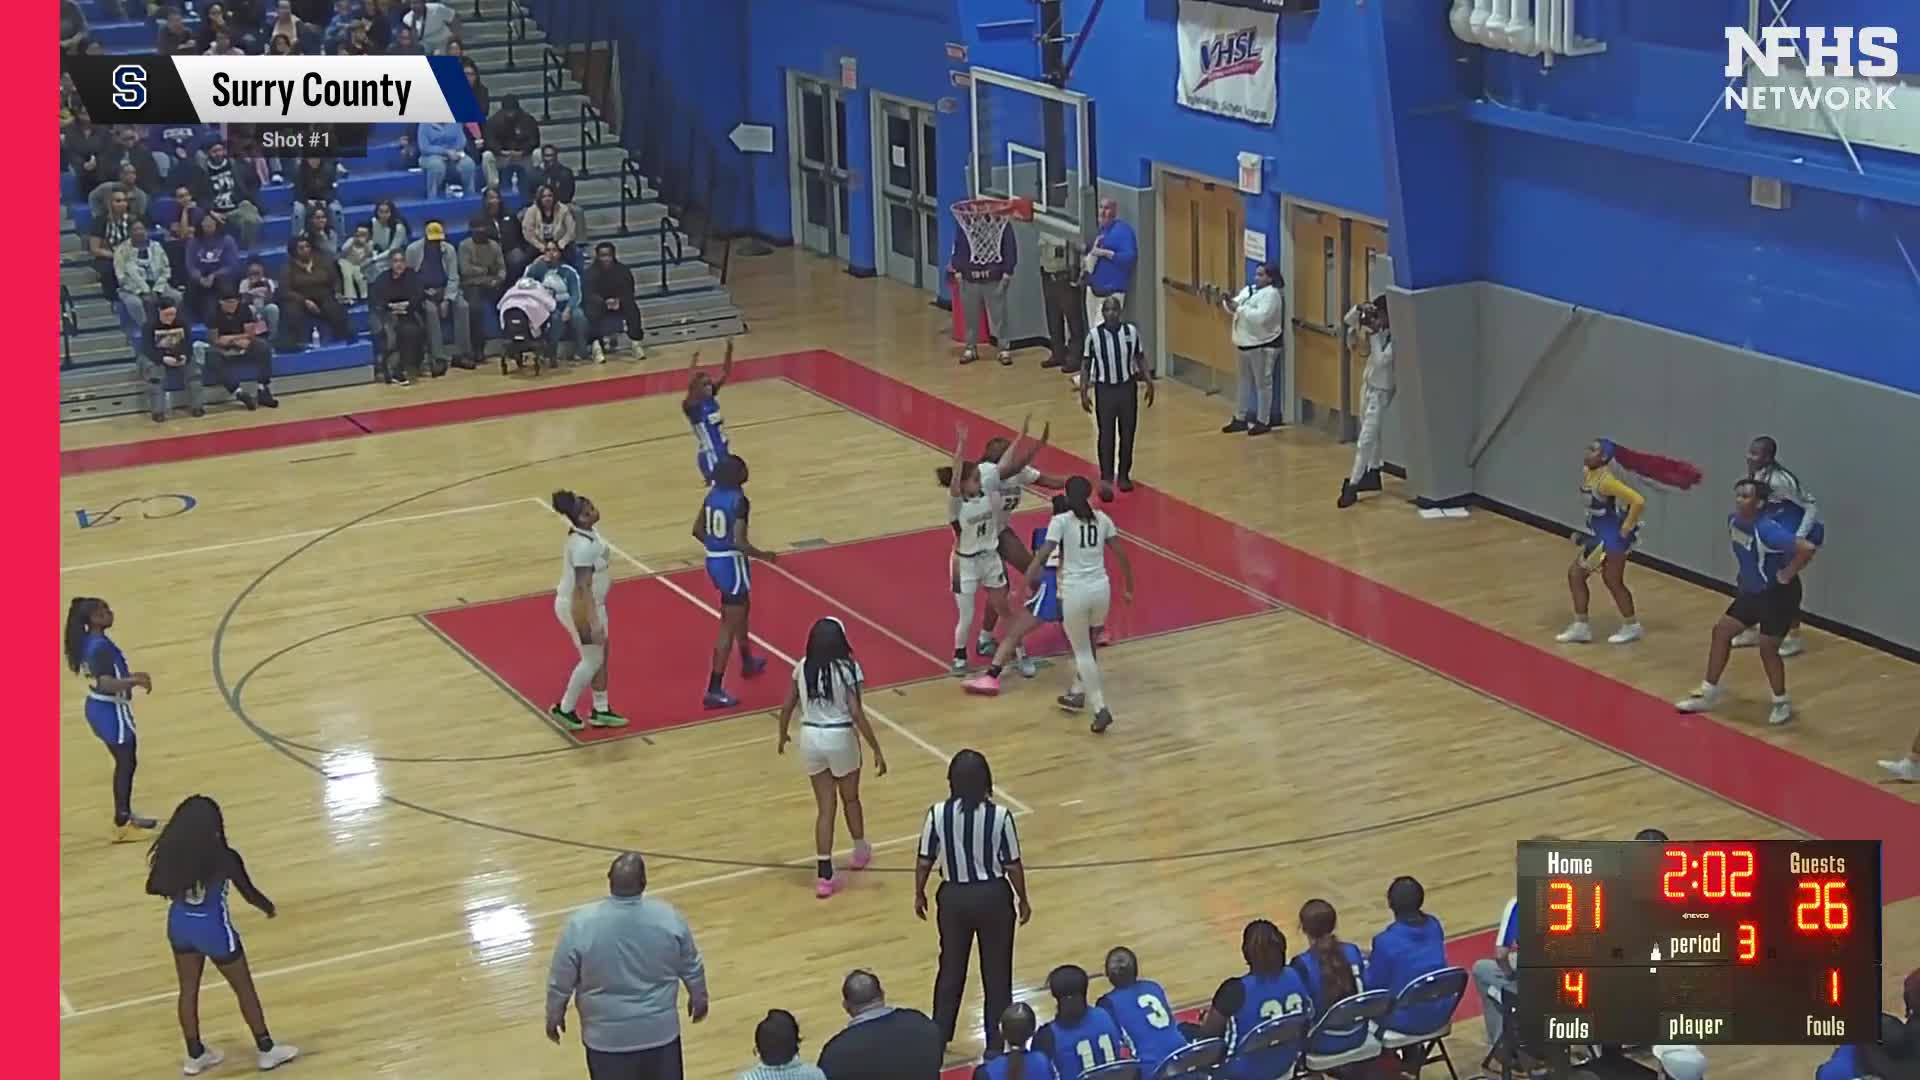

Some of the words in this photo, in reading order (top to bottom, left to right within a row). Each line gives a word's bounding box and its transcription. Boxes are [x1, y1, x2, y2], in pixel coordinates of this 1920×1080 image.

[1200, 26, 1264, 74] VHSL
[705, 506, 727, 538] 10
[1080, 525, 1098, 549] 10
[1137, 994, 1170, 1029] 3
[1076, 1034, 1116, 1071] 11
